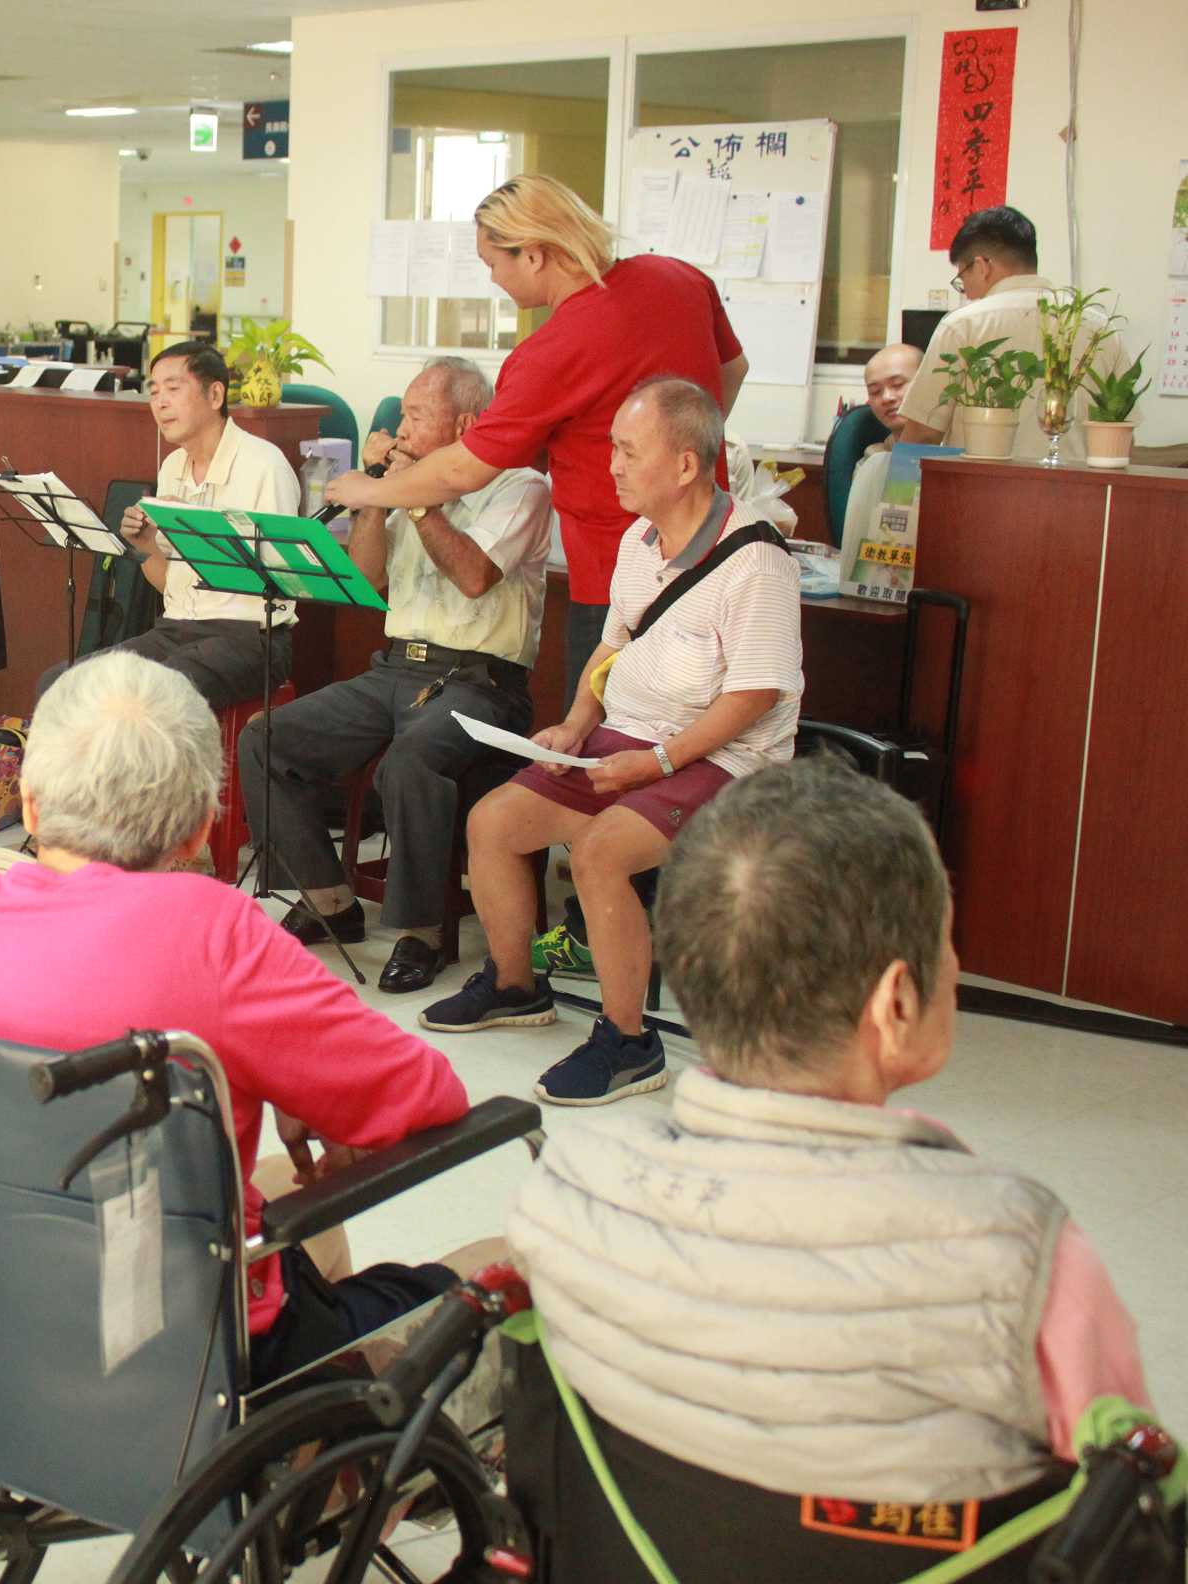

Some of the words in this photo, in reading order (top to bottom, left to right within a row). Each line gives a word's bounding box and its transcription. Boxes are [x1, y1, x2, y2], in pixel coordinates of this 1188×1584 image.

[669, 130, 788, 160] 公佈欄
[961, 101, 994, 214] 四季平
[863, 546, 912, 566] 衛教單張
